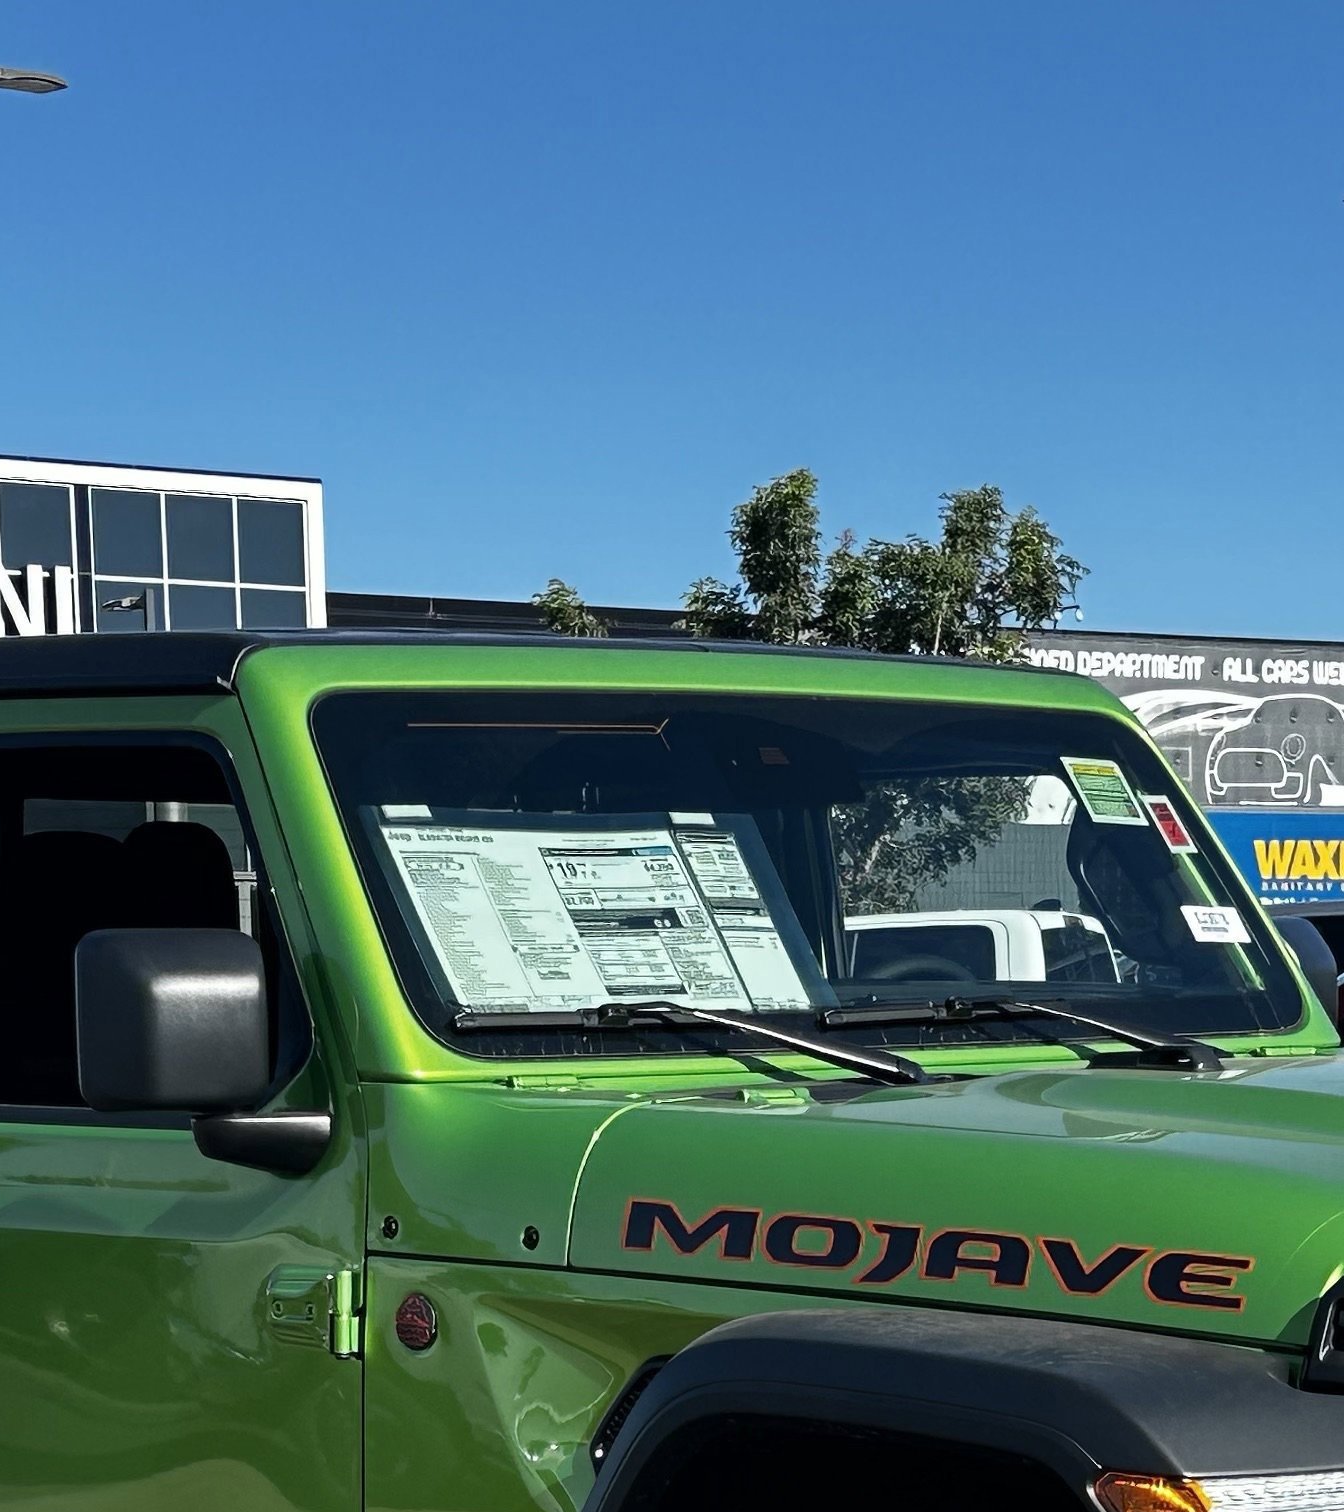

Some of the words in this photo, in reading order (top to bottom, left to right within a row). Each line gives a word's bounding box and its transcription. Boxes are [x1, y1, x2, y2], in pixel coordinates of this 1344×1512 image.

[1076, 651, 1205, 681] DEPARTMENT
[1222, 657, 1259, 683] ALL
[622, 1198, 1255, 1312] MOJAVE
